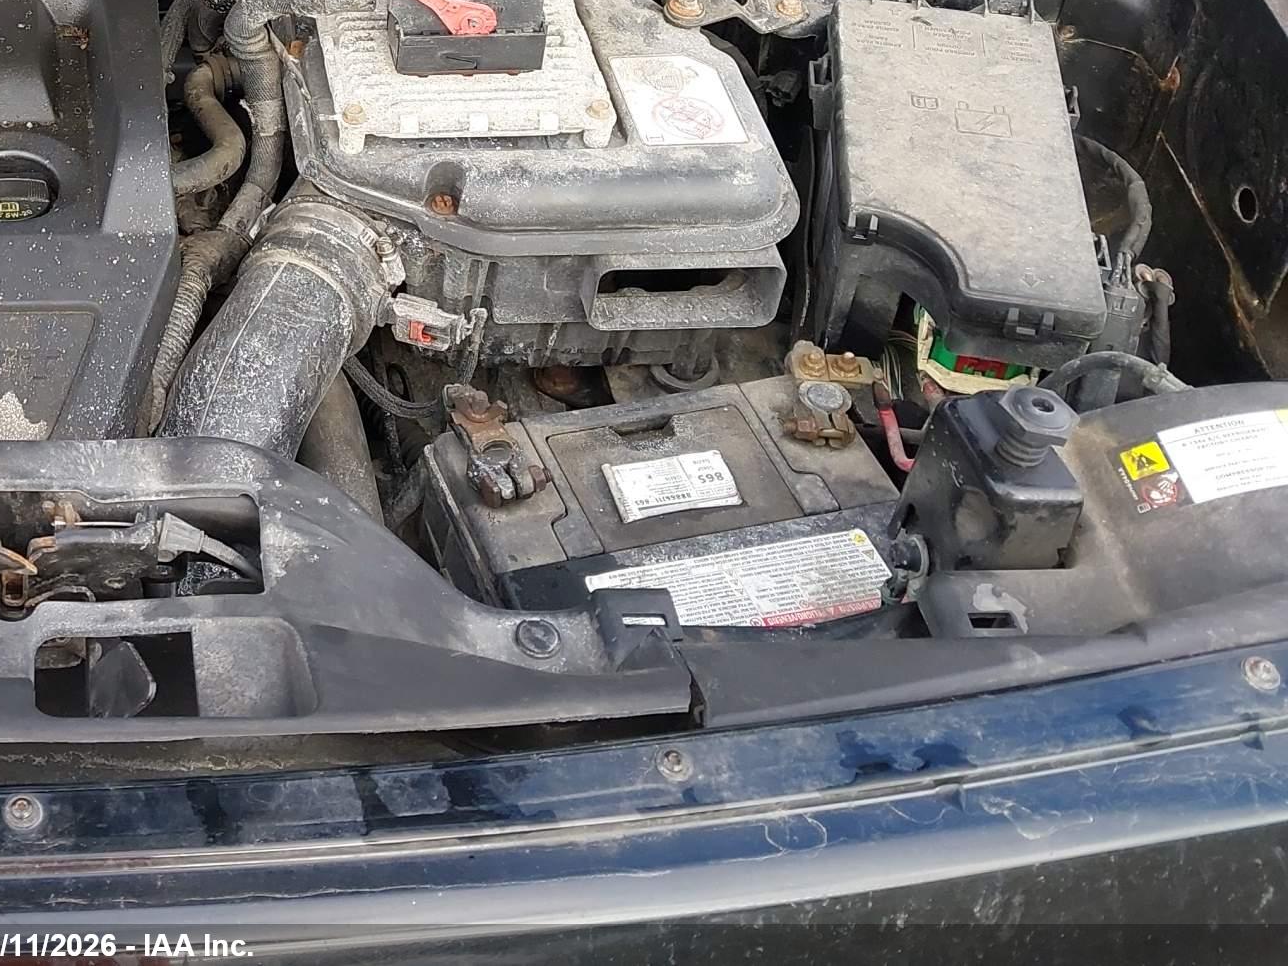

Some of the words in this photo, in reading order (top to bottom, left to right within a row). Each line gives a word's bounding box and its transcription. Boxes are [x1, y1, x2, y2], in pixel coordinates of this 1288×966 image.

[5, 209, 33, 219] 5W-20
[1194, 419, 1246, 434] ATTENTION
[697, 471, 725, 484] 865
